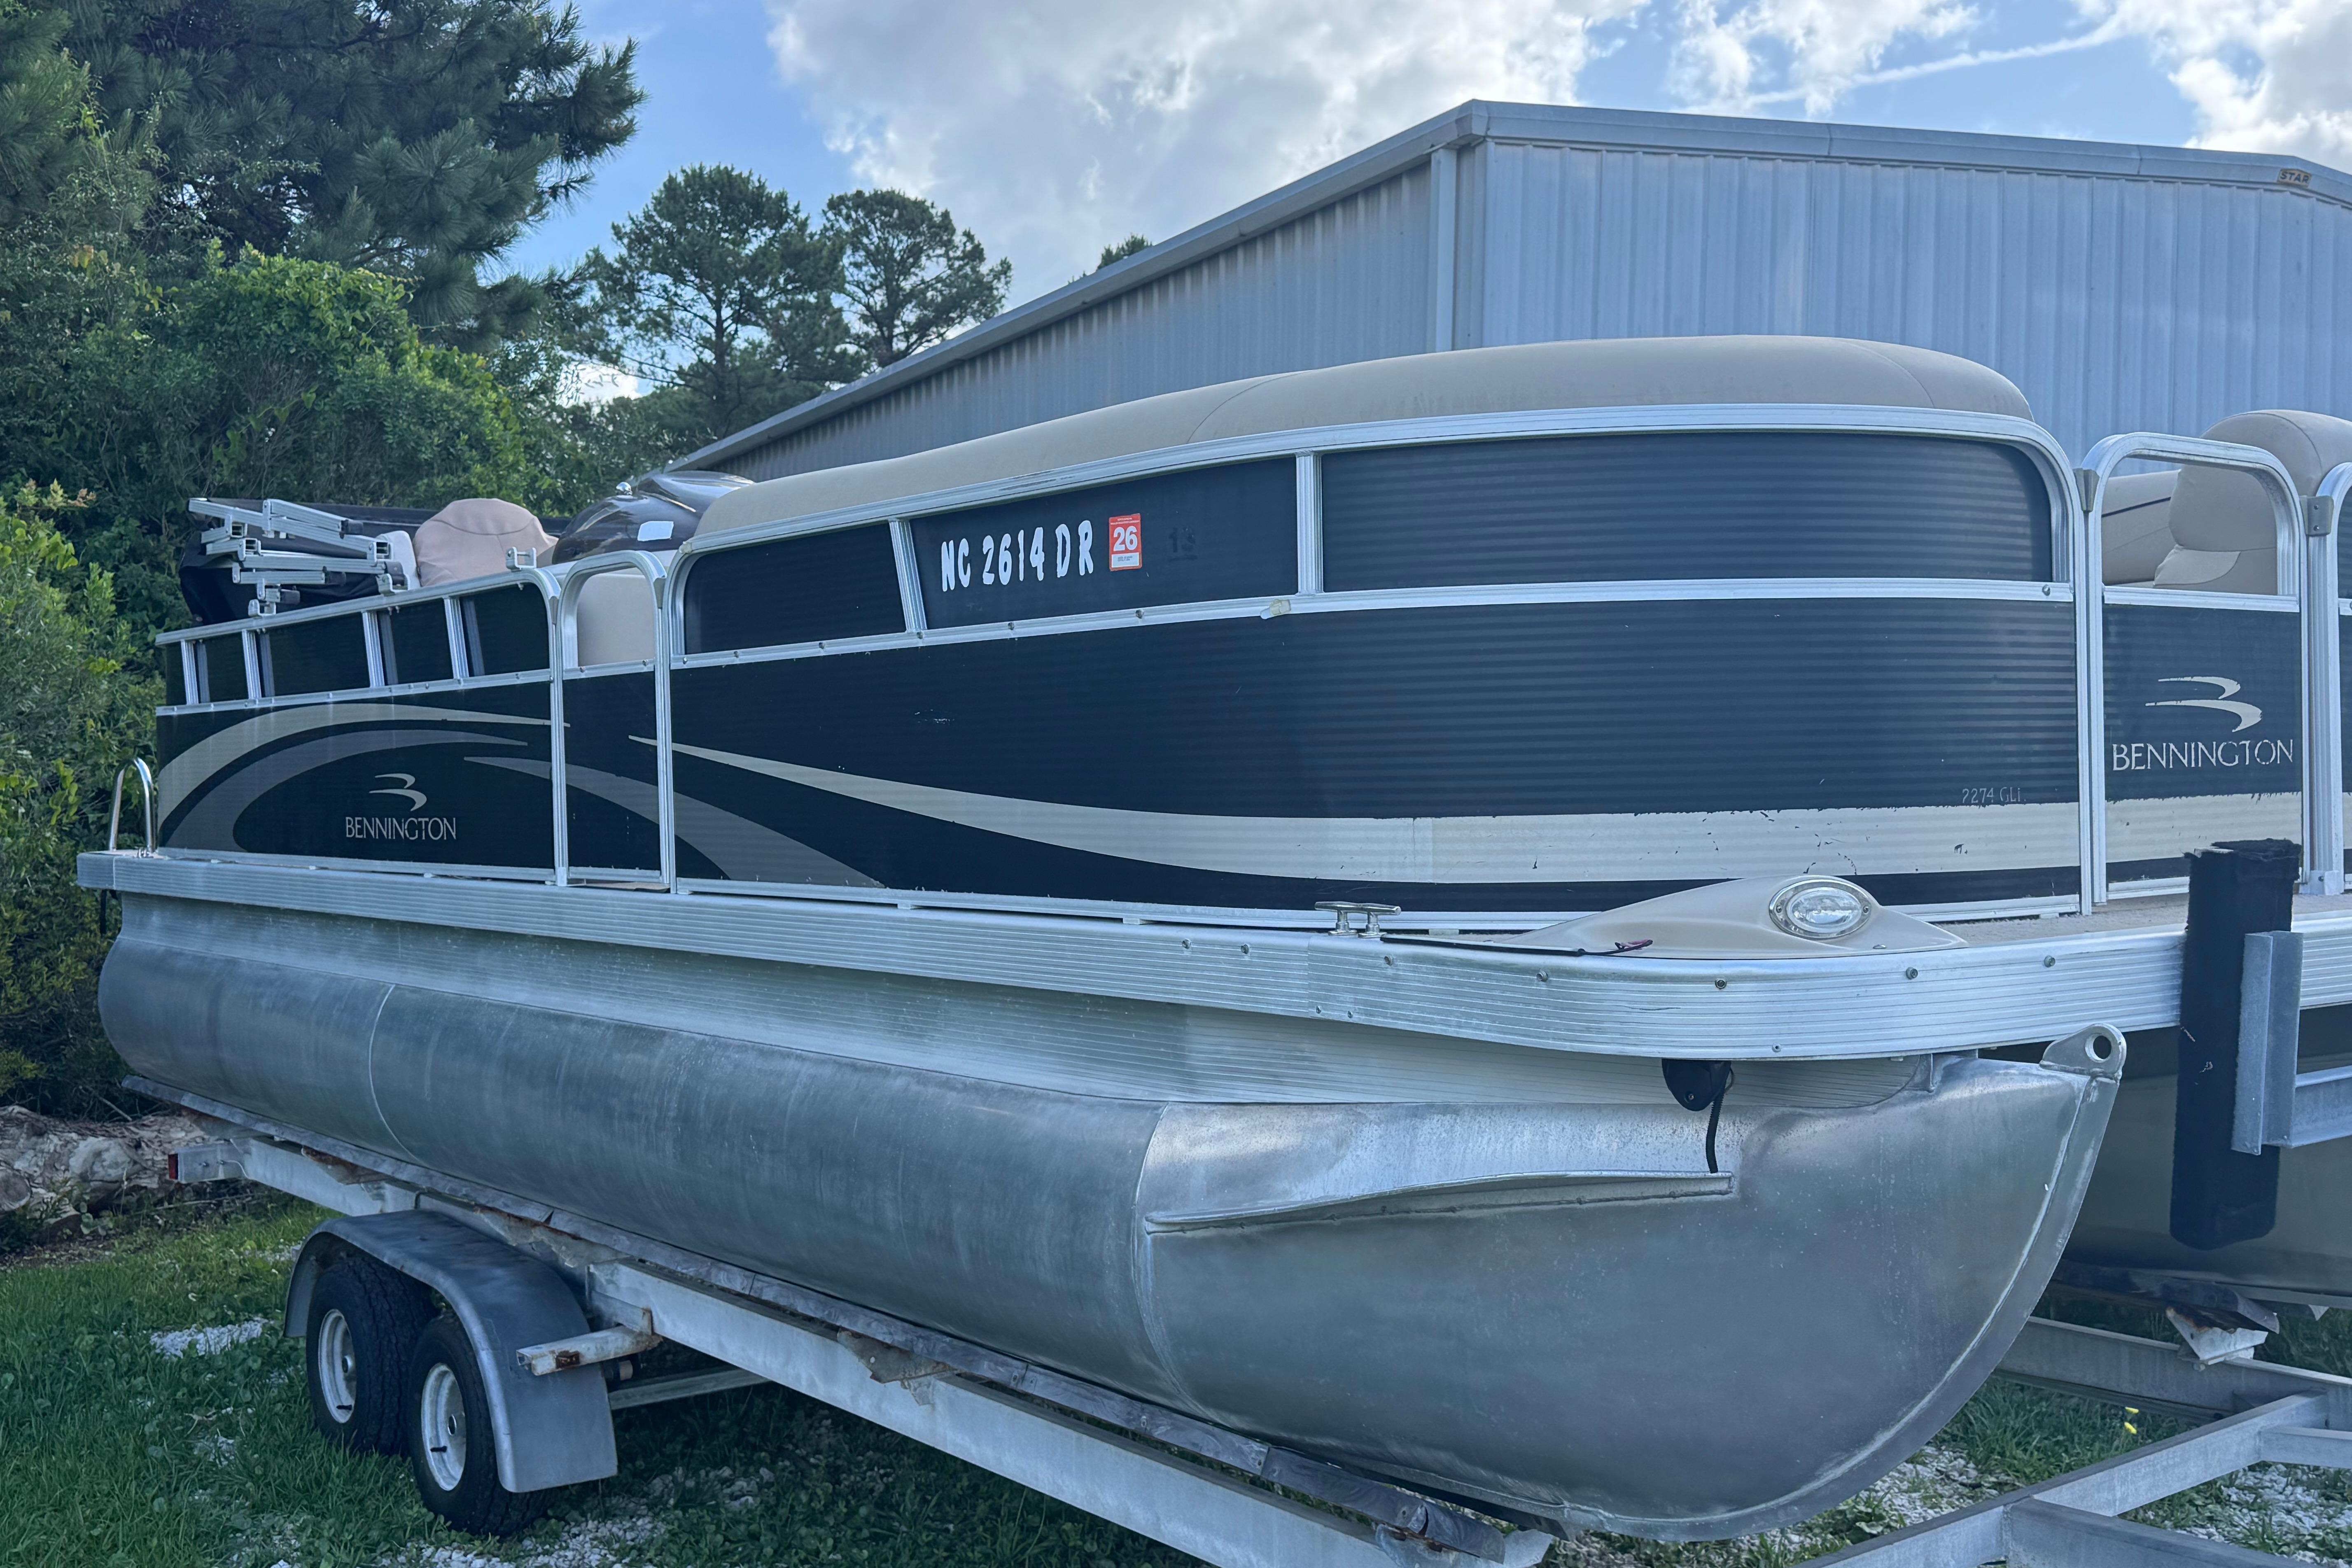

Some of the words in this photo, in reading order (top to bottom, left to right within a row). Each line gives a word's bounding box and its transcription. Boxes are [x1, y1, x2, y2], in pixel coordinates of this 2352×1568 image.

[2280, 171, 2309, 183] STAR
[1113, 526, 1137, 551] 26
[942, 539, 971, 592] NC
[983, 527, 1044, 585] 2614
[1055, 520, 1093, 578] DR
[2113, 740, 2293, 770] BENNINGTON
[1963, 788, 1994, 803] 2274
[346, 817, 456, 840] BENNINGTON
